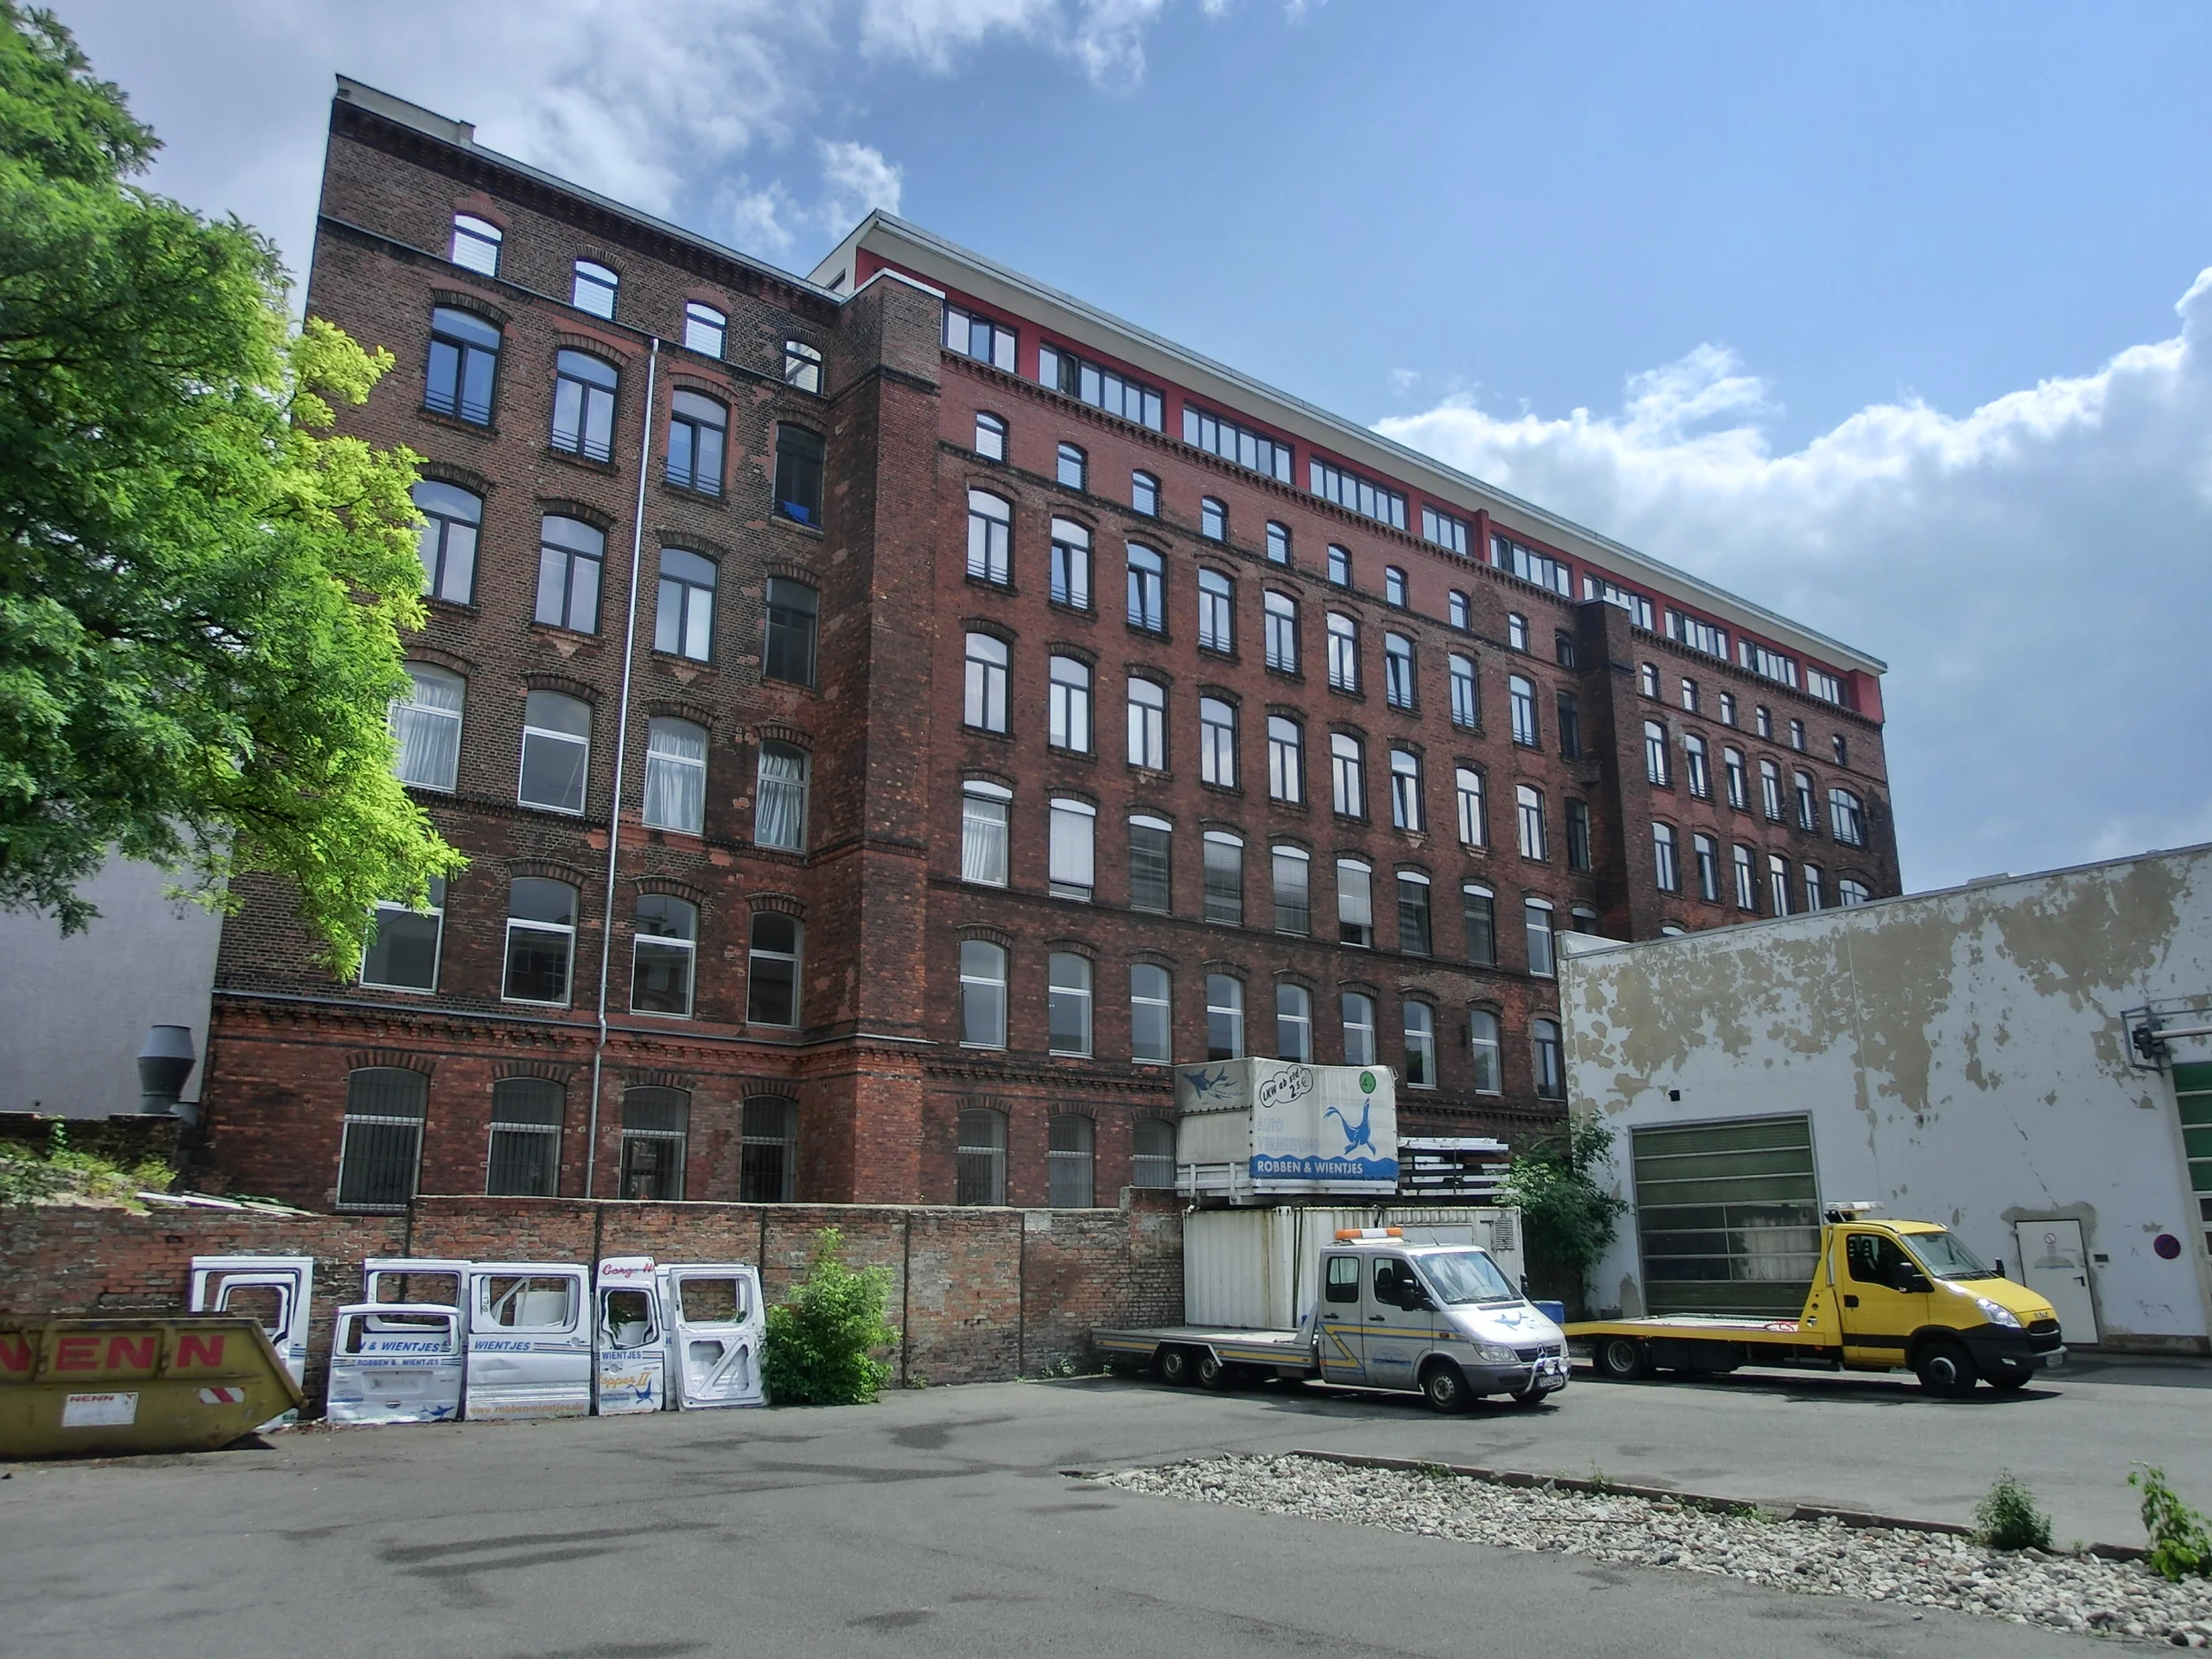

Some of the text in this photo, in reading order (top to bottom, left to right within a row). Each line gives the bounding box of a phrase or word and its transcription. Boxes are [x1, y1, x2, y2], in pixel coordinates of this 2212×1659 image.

[1263, 1084, 1277, 1102] LKW
[1279, 1078, 1287, 1089] ab
[1256, 1117, 1284, 1133] AUTO
[1257, 1161, 1363, 1174] ROBBEN & WIENTJES
[368, 1341, 377, 1350] &
[381, 1341, 441, 1352] WIENTJES
[474, 1340, 531, 1351] WIENTJES
[602, 1350, 641, 1360] WIENTJES
